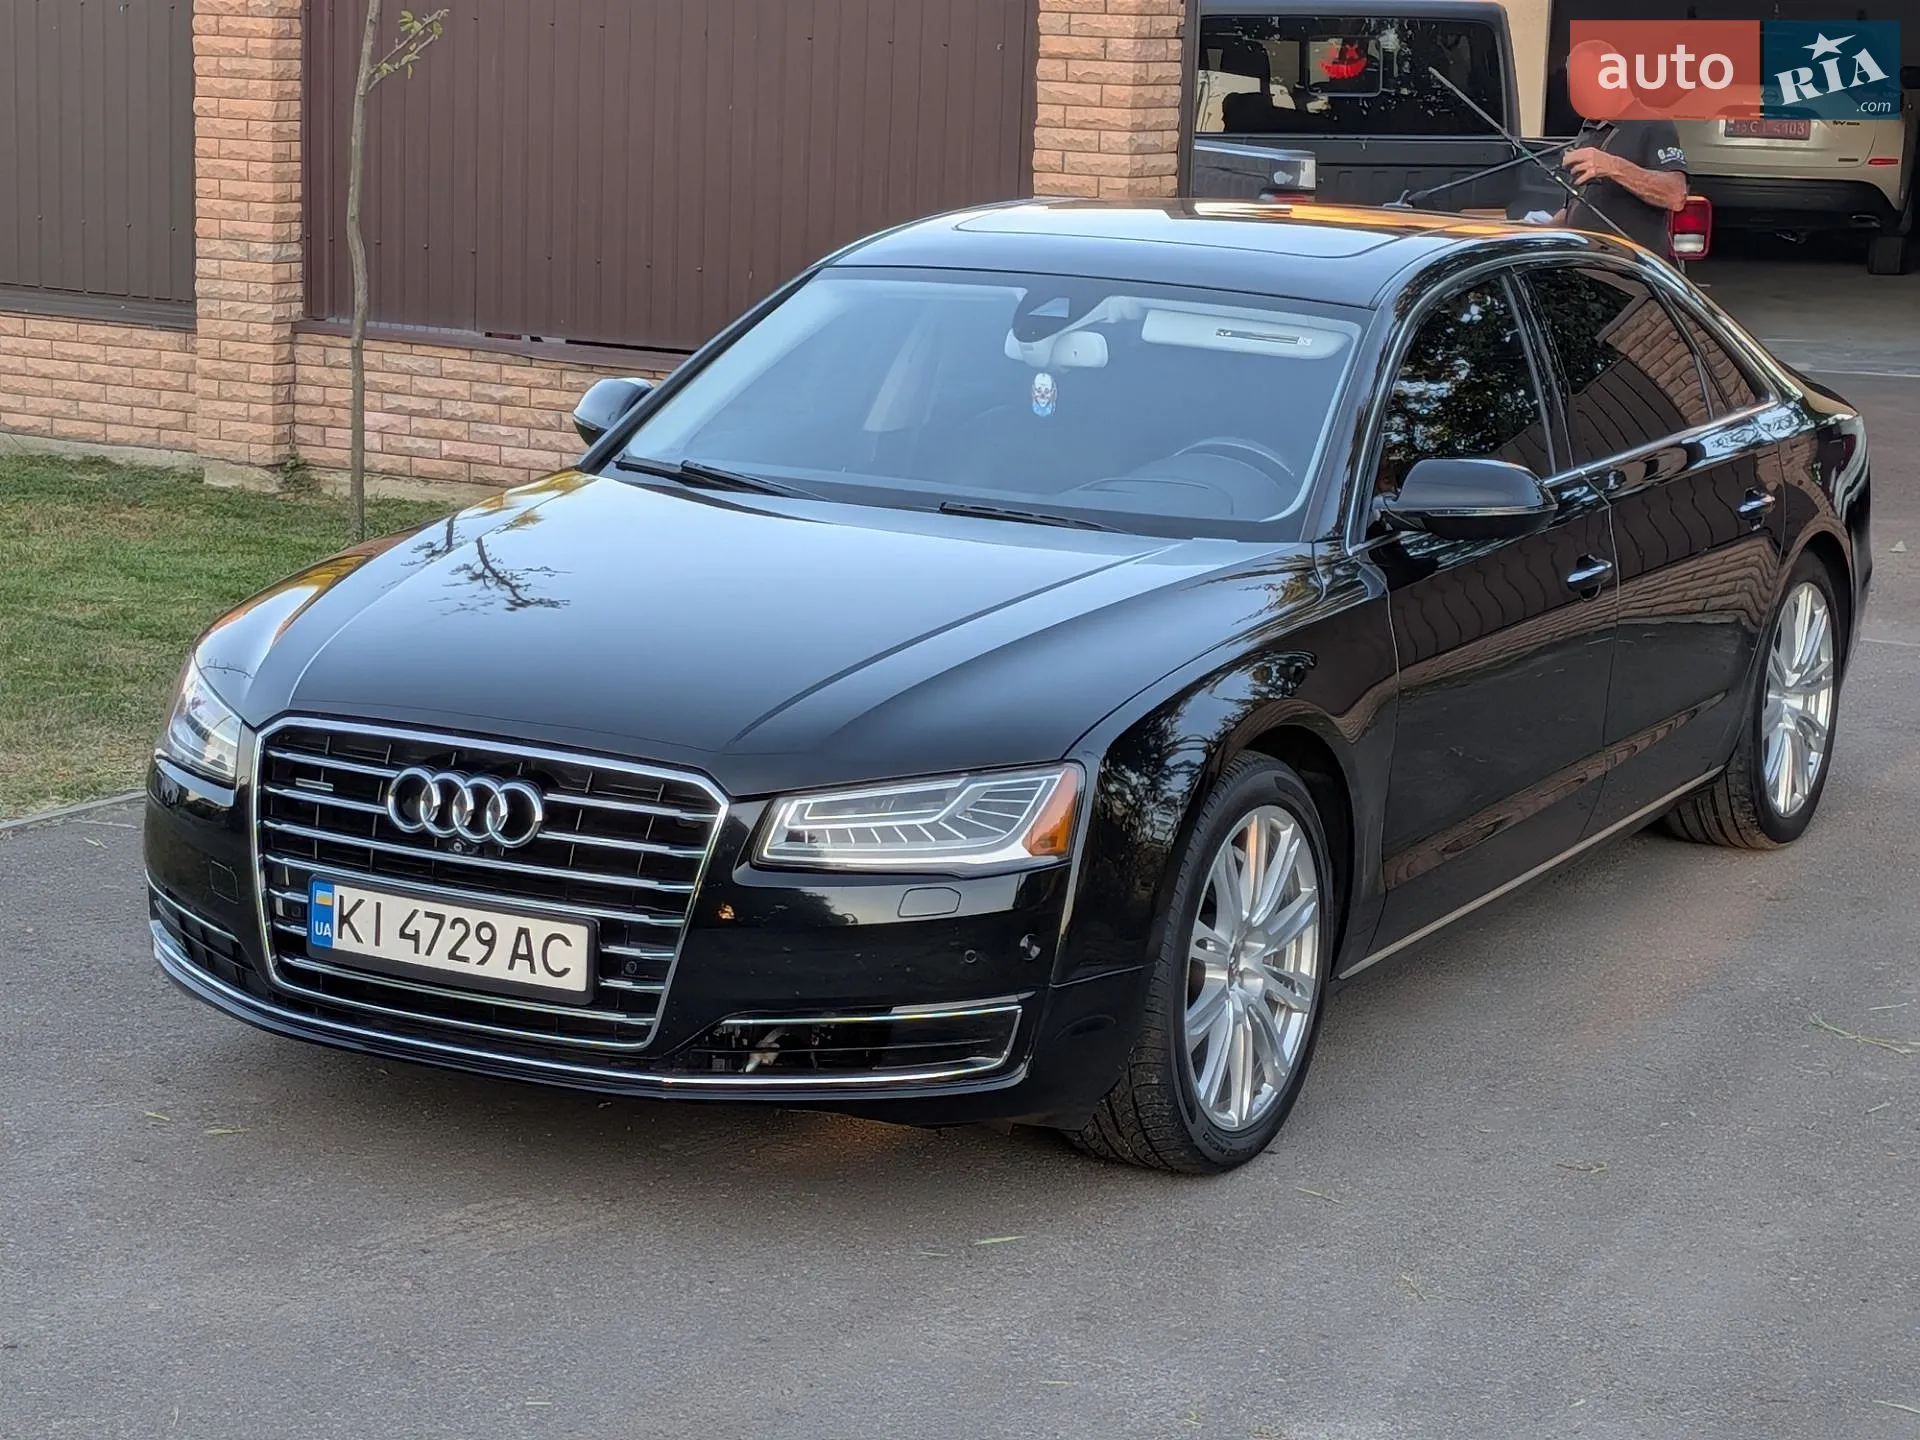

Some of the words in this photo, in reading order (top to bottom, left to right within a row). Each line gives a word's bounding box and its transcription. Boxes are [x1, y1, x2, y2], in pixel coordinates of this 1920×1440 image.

[315, 920, 332, 937] UA
[337, 895, 381, 947] KI
[399, 908, 498, 966] 4729
[507, 926, 573, 978] AC
